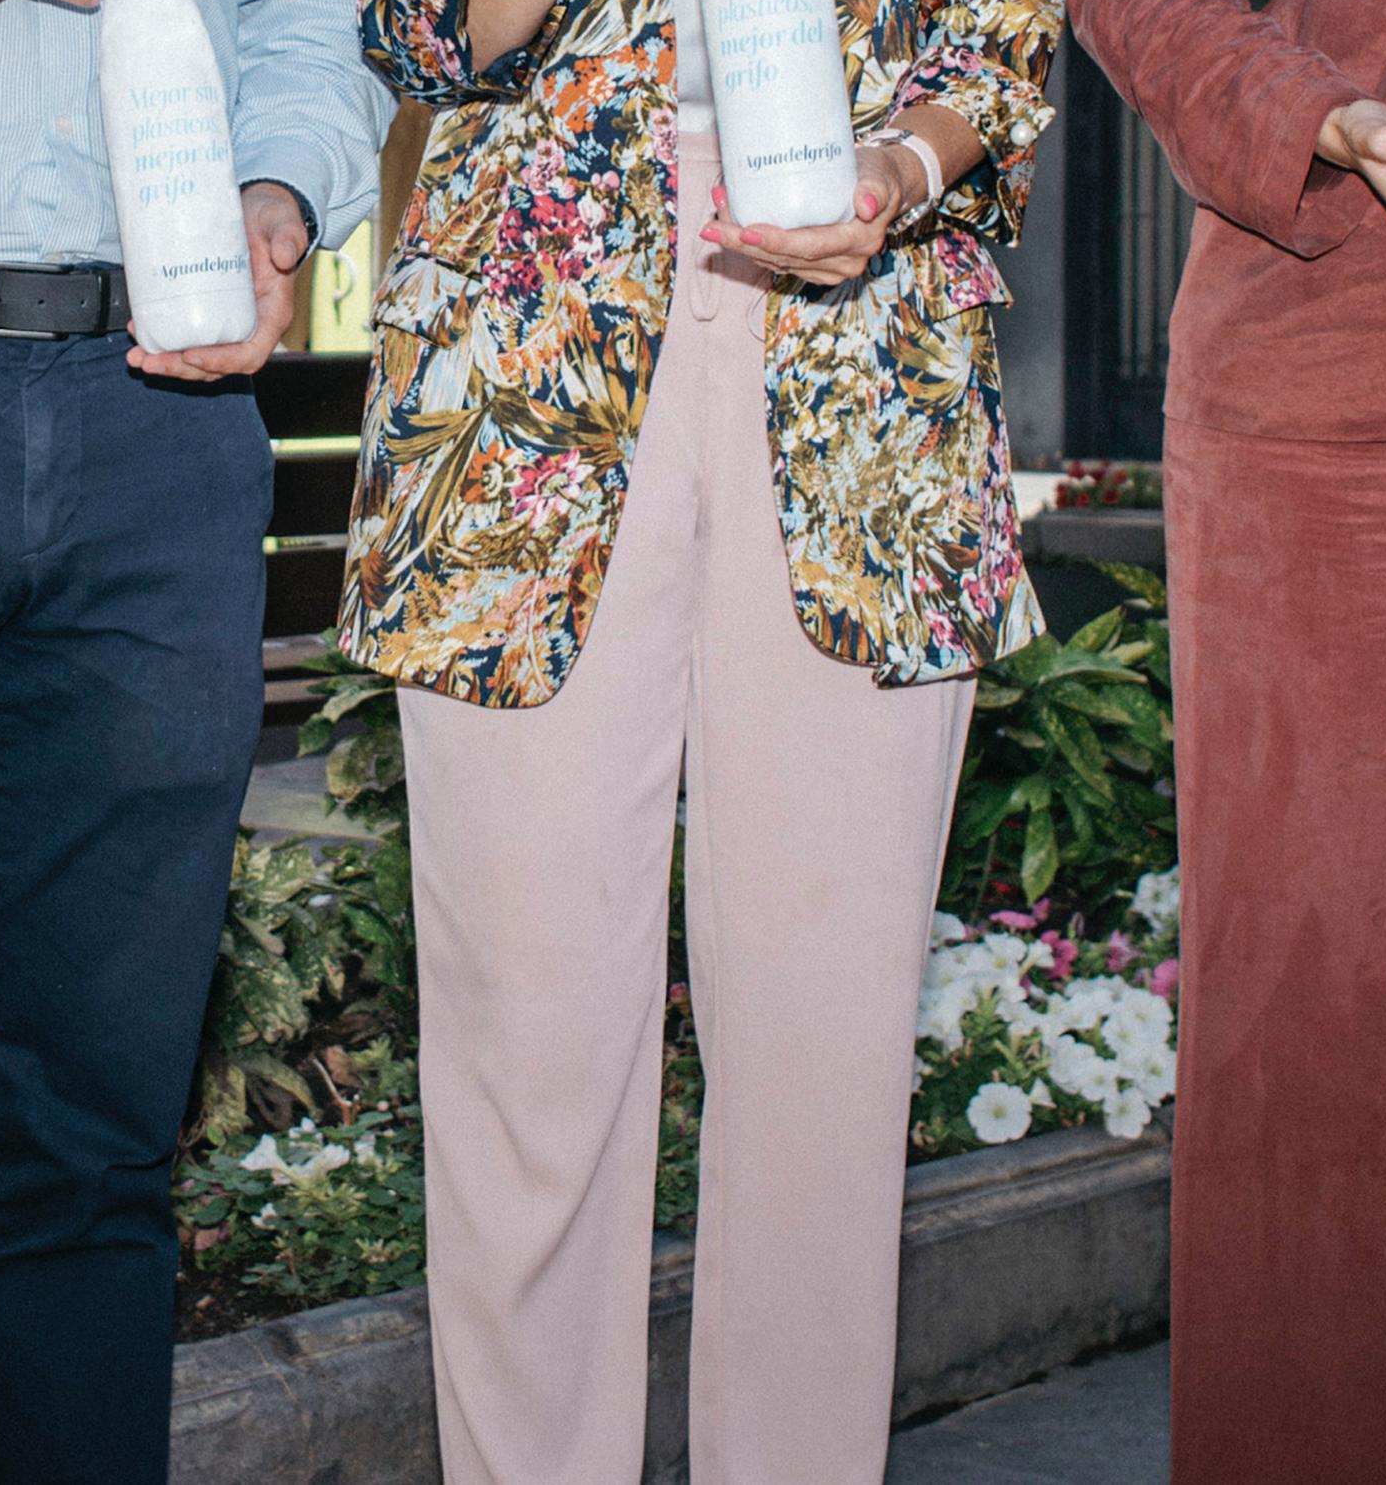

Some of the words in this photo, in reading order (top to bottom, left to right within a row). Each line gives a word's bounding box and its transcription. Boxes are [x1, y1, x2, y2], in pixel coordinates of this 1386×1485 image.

[720, 27, 788, 58] mejor
[791, 17, 823, 45] del
[725, 60, 779, 95] grifo
[129, 85, 191, 111] Mejor
[133, 146, 199, 173] mejor
[138, 175, 196, 209] grifo
